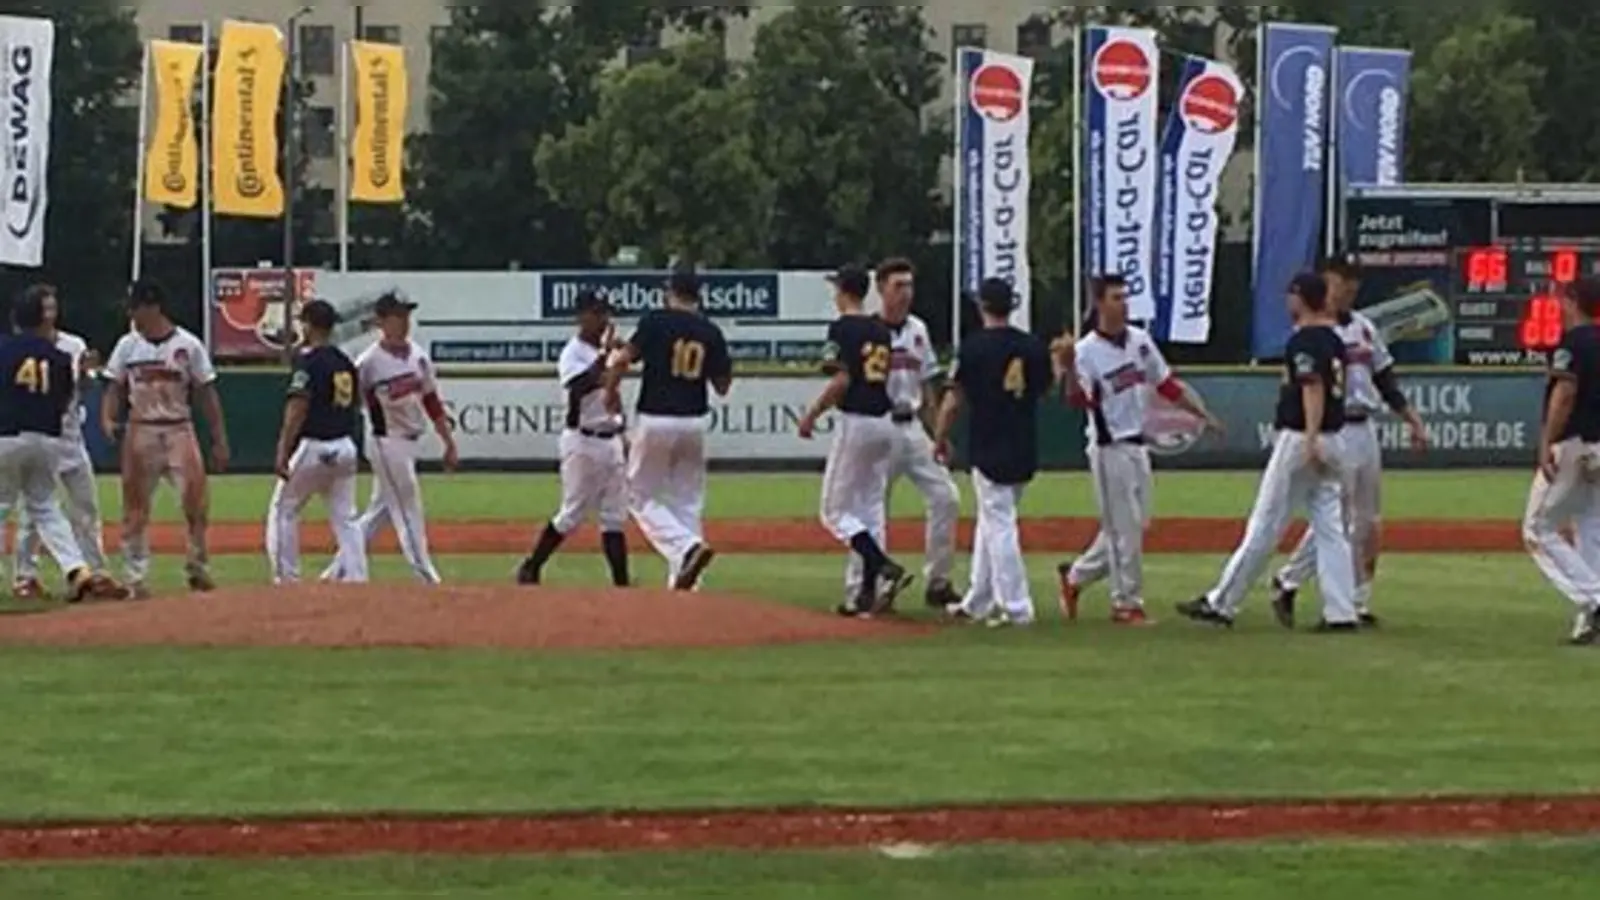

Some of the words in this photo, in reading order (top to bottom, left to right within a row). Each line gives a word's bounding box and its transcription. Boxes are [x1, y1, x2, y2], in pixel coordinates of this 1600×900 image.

[1304, 65, 1324, 128] NORD
[9, 45, 34, 204] DEWAG
[235, 67, 265, 198] Continental
[369, 73, 389, 188] Continental
[1359, 214, 1403, 231] Jetzt
[1556, 252, 1577, 283] 0
[15, 357, 49, 394] 41
[671, 338, 705, 378] 10
[1004, 357, 1027, 398] 4
